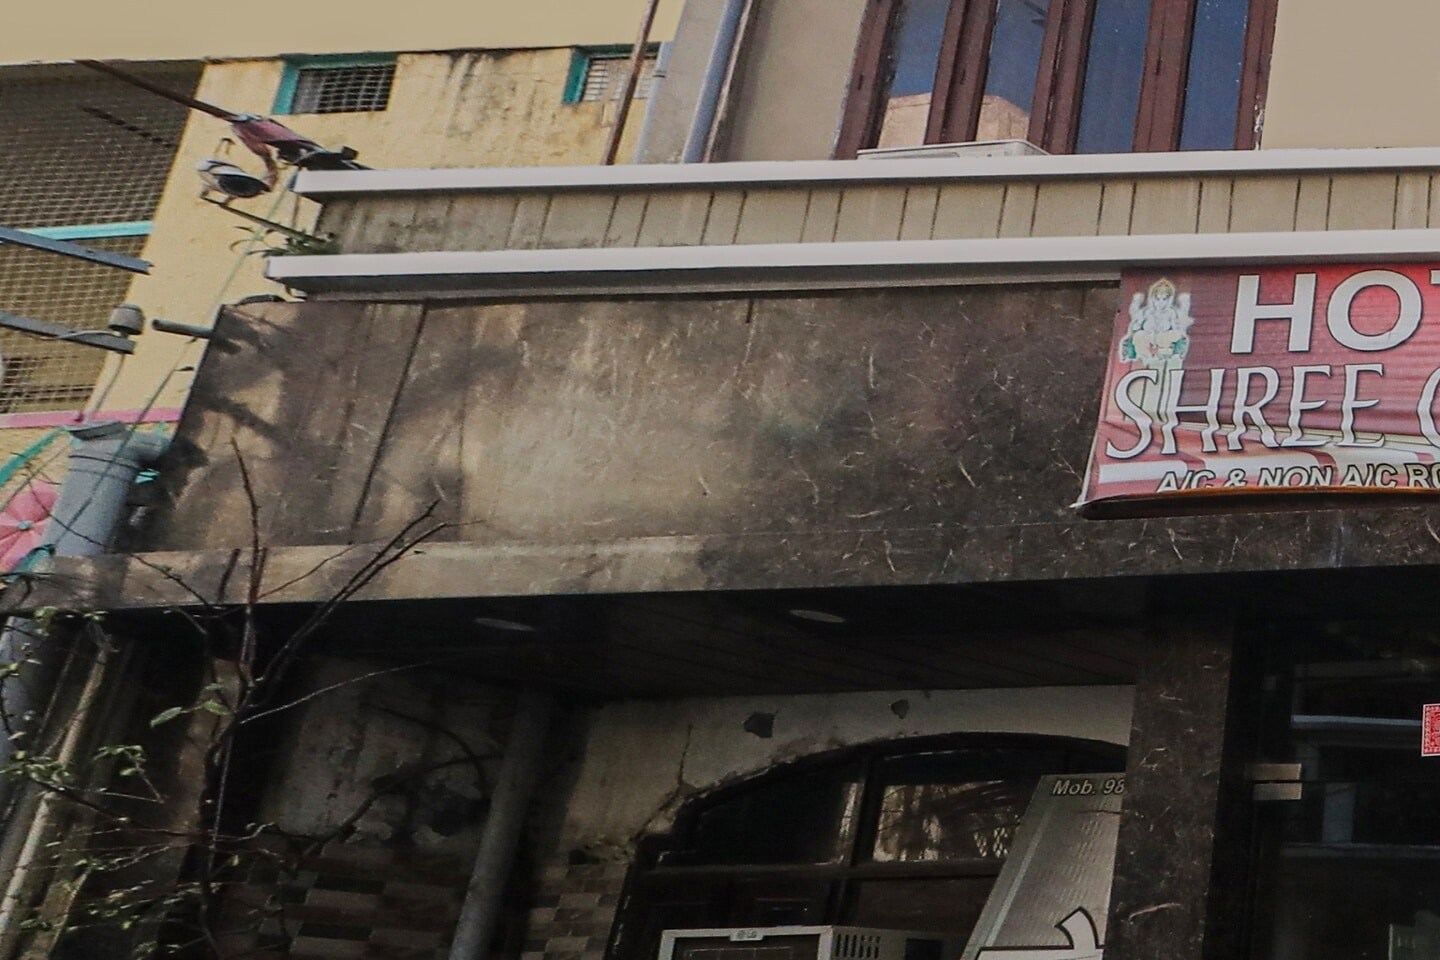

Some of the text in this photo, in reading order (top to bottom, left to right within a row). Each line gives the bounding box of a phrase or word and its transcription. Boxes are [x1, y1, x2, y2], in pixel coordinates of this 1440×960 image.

[1106, 362, 1385, 459] SHREE
[1224, 467, 1248, 488] &
[1257, 465, 1334, 488] NON
[1340, 463, 1399, 488] A/C
[1053, 779, 1096, 795] Mob.
